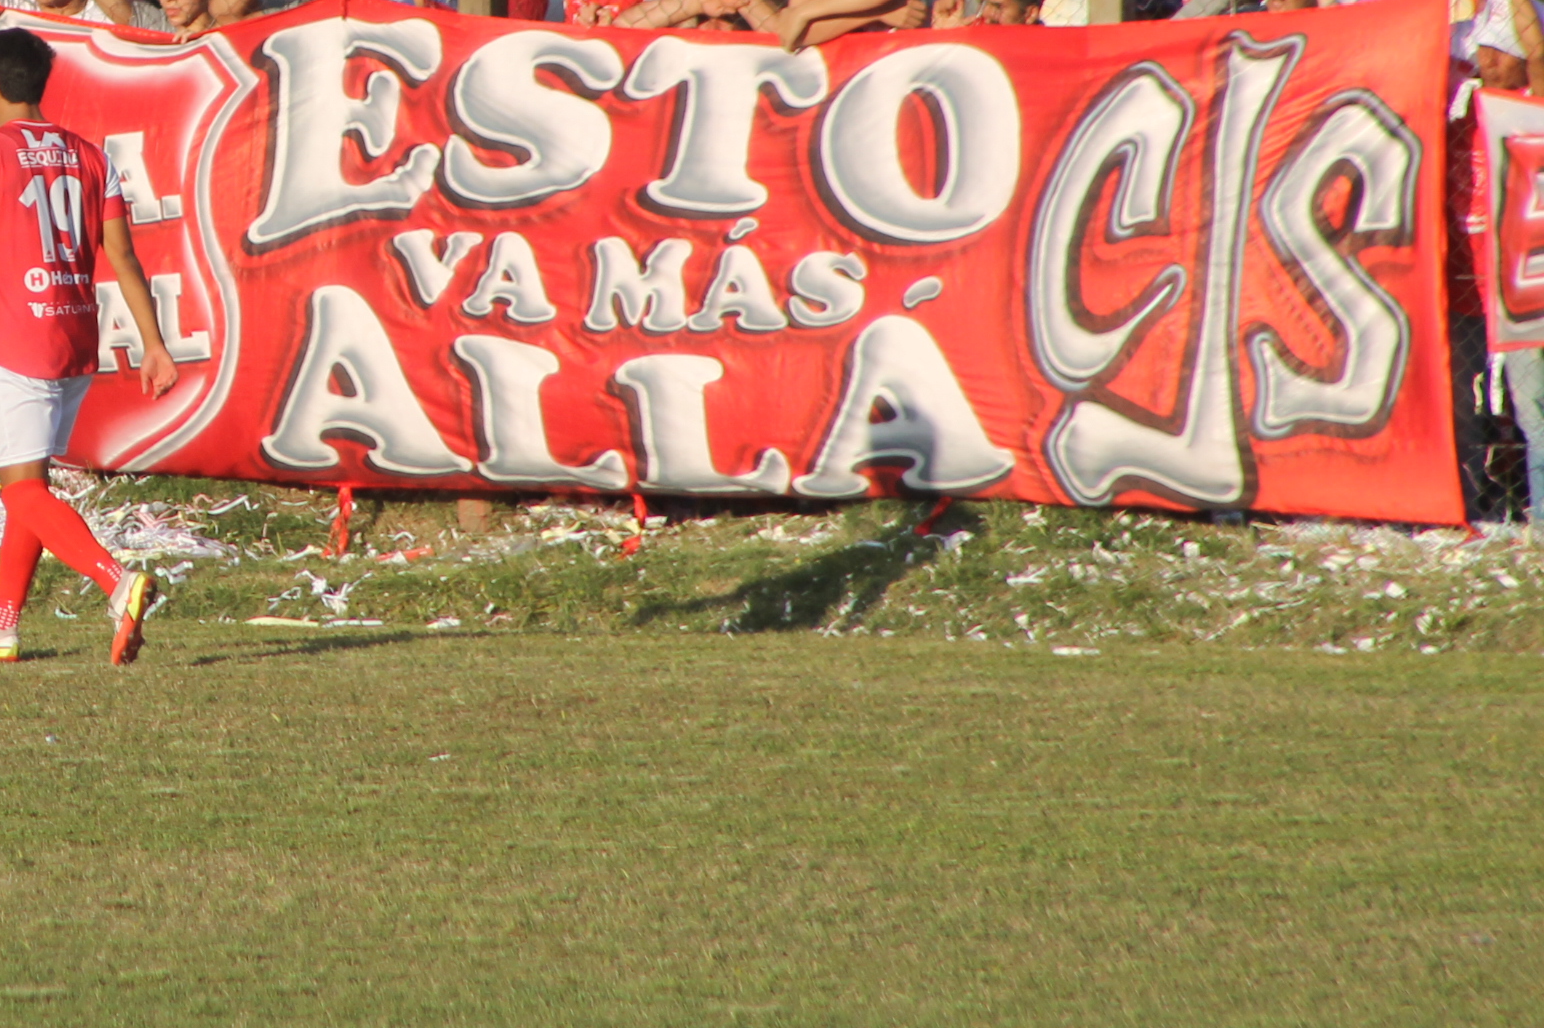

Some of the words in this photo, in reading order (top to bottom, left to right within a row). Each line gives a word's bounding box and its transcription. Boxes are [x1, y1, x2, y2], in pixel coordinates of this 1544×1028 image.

[17, 148, 79, 167] ESQUINA
[246, 17, 1022, 244] ESTO
[18, 175, 82, 263] 19
[584, 216, 868, 332] MÁS
[260, 276, 1017, 497] ALLÁ
